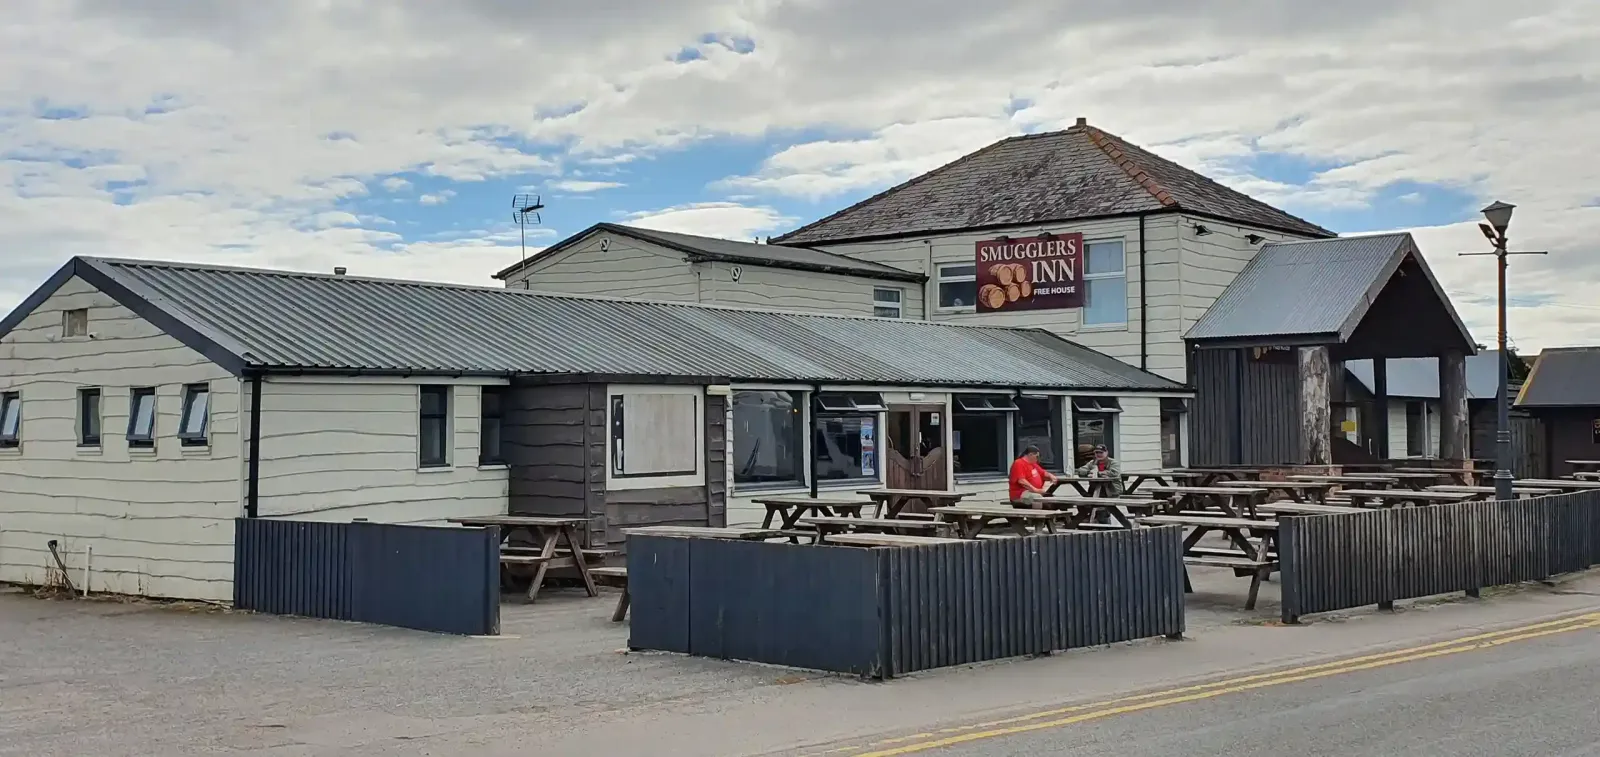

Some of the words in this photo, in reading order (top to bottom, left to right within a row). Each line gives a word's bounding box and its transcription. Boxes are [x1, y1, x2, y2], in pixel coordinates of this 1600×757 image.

[980, 239, 1076, 262] SMUGGLERS
[1031, 258, 1076, 284] INN
[1033, 287, 1050, 295] FREE
[1051, 286, 1076, 294] HOUSE
